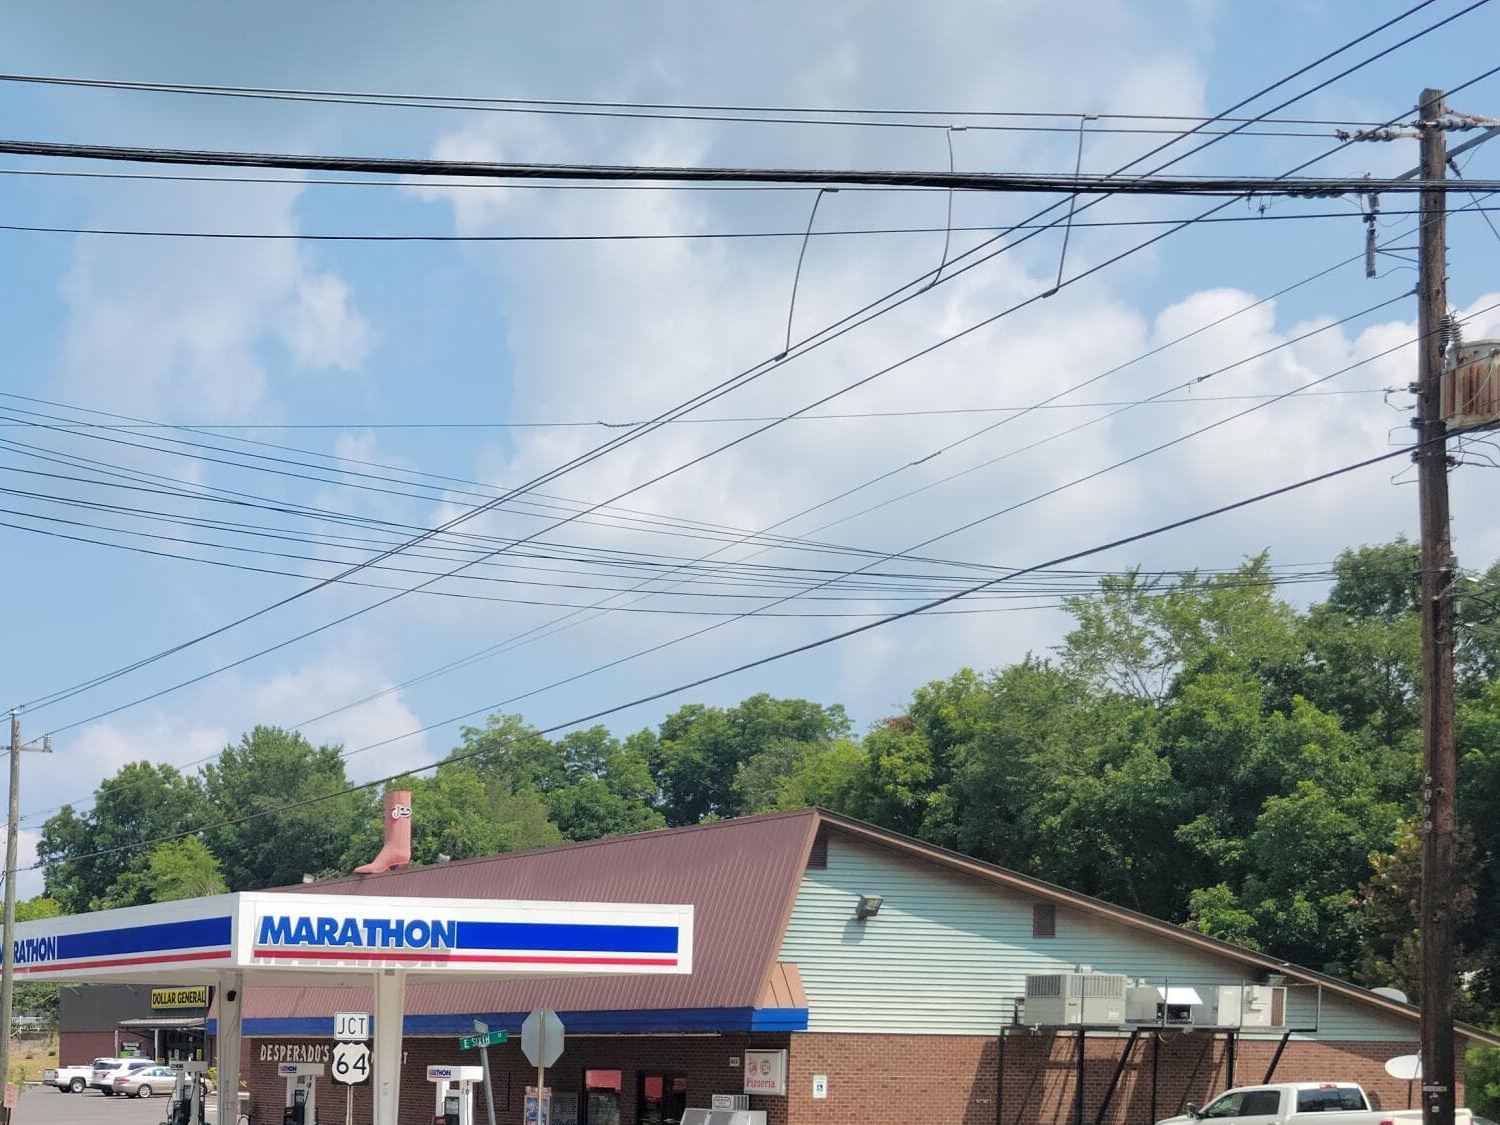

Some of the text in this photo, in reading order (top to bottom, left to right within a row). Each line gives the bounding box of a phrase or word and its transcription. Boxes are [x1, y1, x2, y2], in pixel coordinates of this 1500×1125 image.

[258, 915, 456, 949] MARATHON
[152, 990, 205, 1005] DOLLAR GENERAL
[337, 1017, 366, 1035] JCT
[260, 1044, 330, 1062] DESPERADO'S
[463, 1039, 470, 1049] E
[336, 1052, 367, 1075] 64
[745, 1078, 776, 1089] Pizzeria
